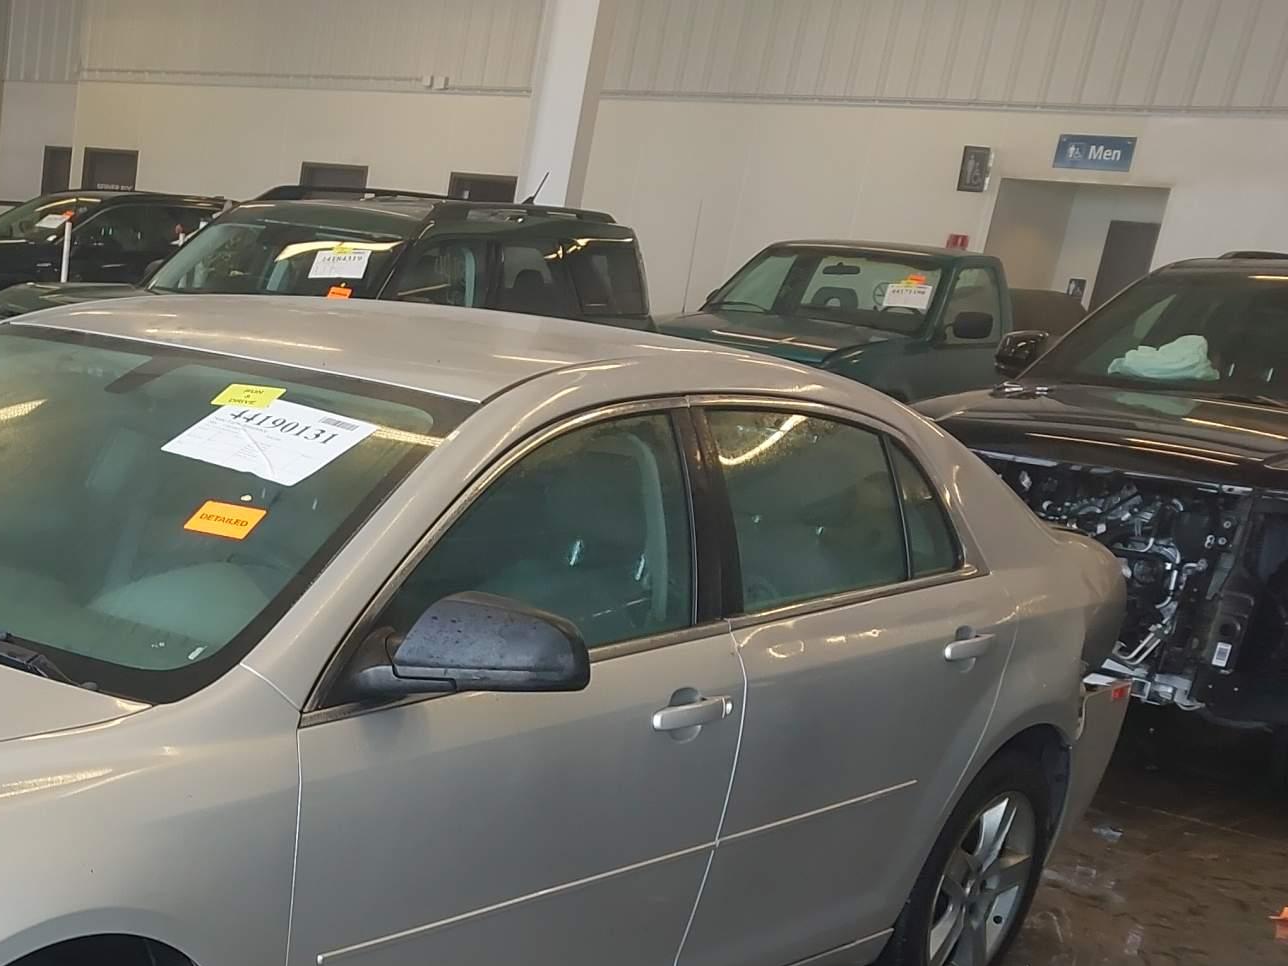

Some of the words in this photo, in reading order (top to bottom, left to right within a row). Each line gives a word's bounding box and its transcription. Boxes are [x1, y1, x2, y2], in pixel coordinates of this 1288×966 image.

[1088, 144, 1121, 161] Men
[229, 409, 340, 444] 44190131
[199, 512, 249, 528] DETAILED
